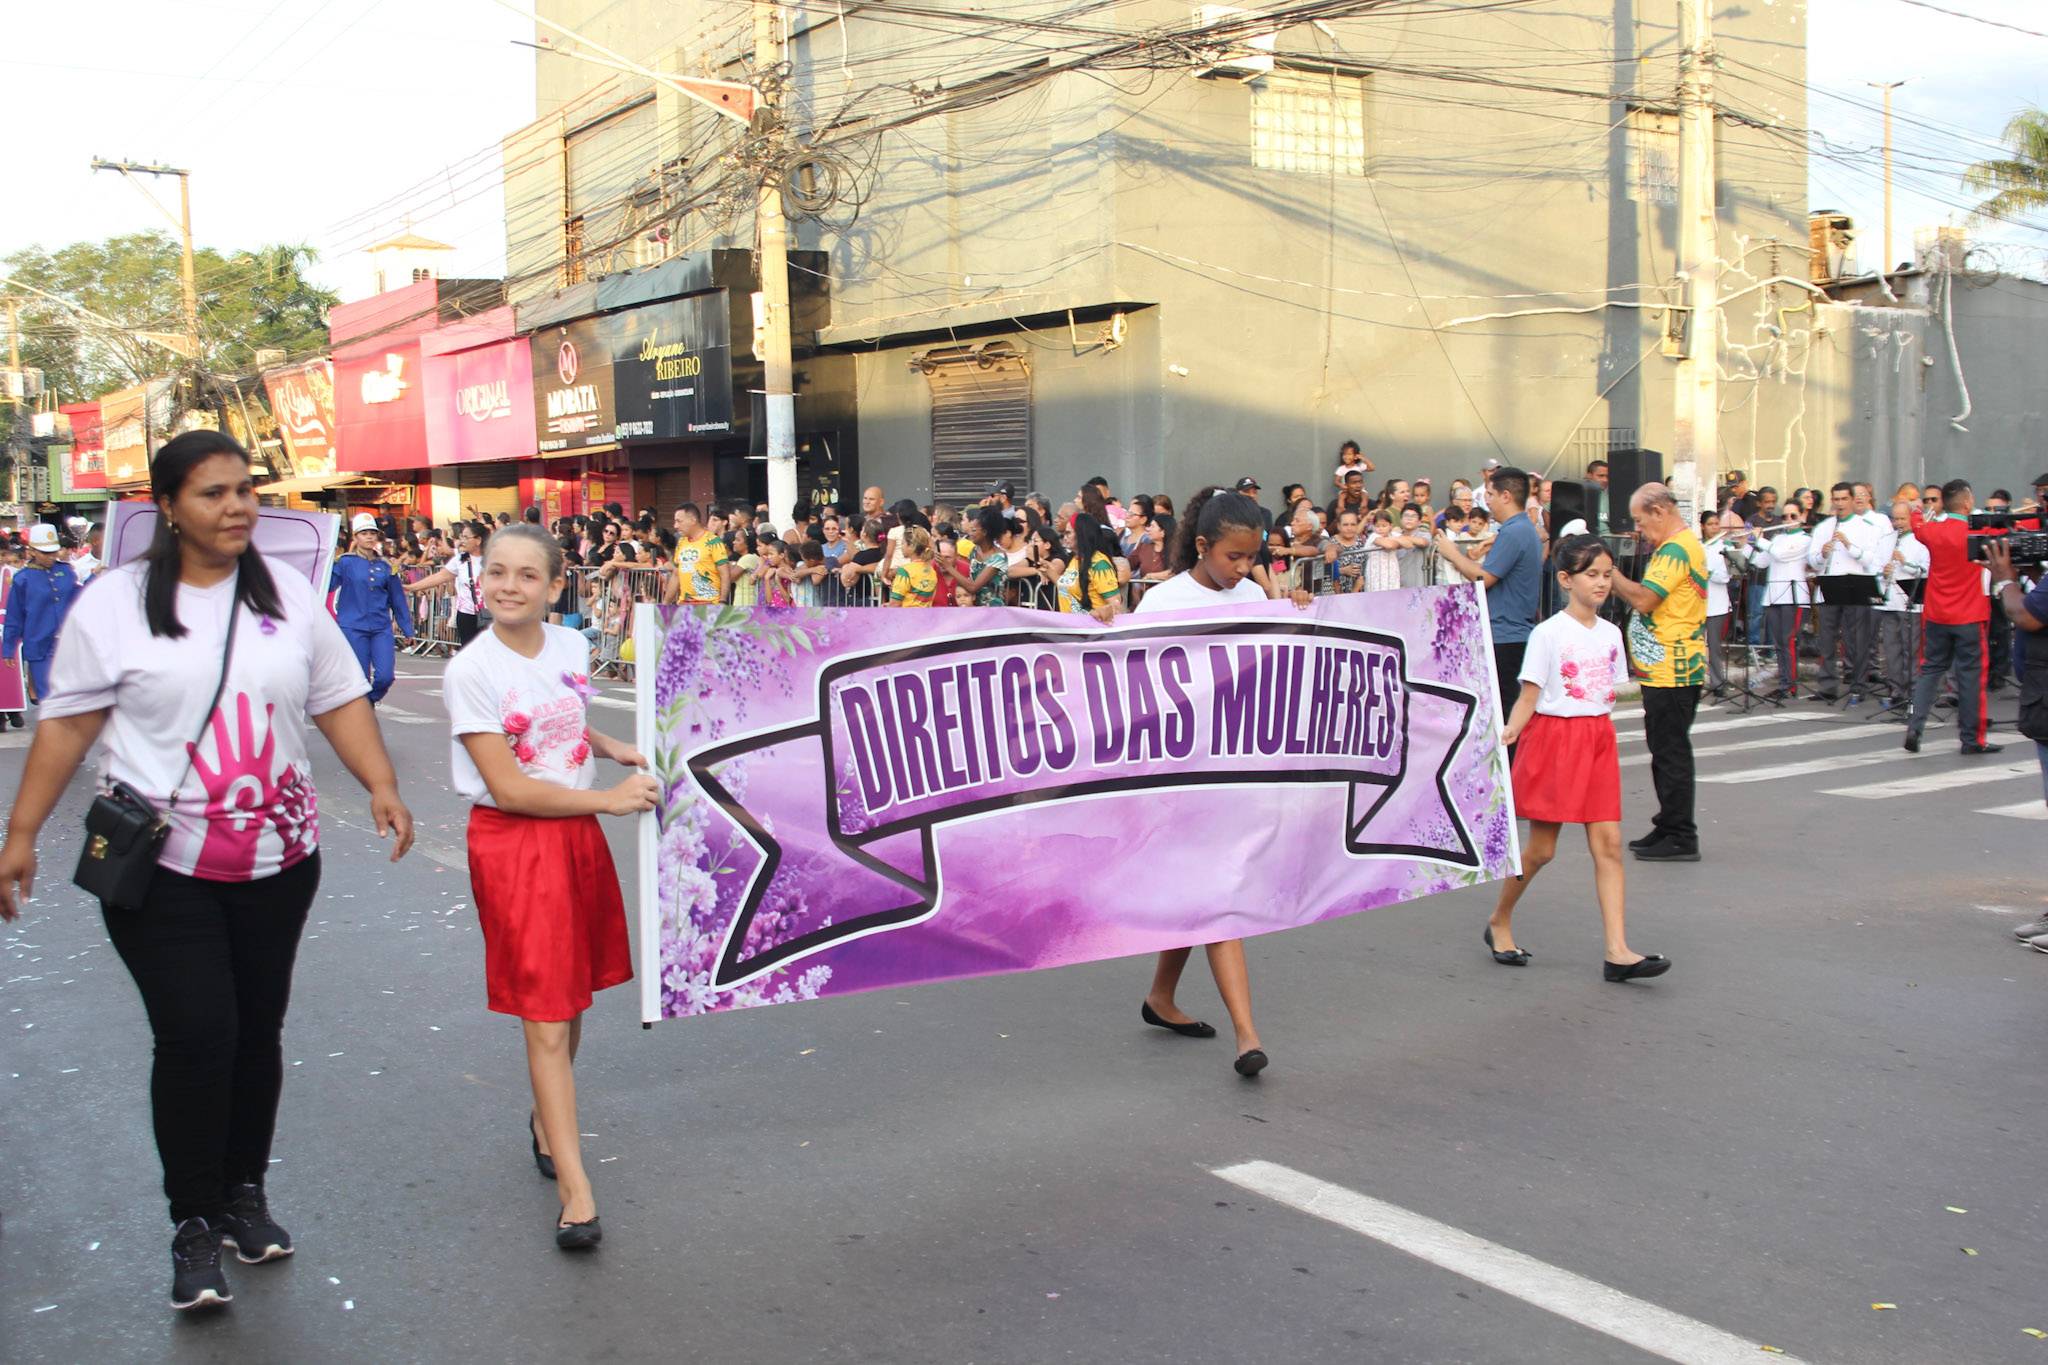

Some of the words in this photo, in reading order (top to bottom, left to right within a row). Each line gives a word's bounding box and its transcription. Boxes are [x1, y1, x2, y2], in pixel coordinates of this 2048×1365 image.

[656, 357, 700, 380] RIBEIRO
[456, 380, 511, 421] ORIGINAL
[838, 655, 1077, 812] DIREITOS
[1082, 645, 1196, 765] DAS
[1209, 643, 1399, 760] MULHERES
